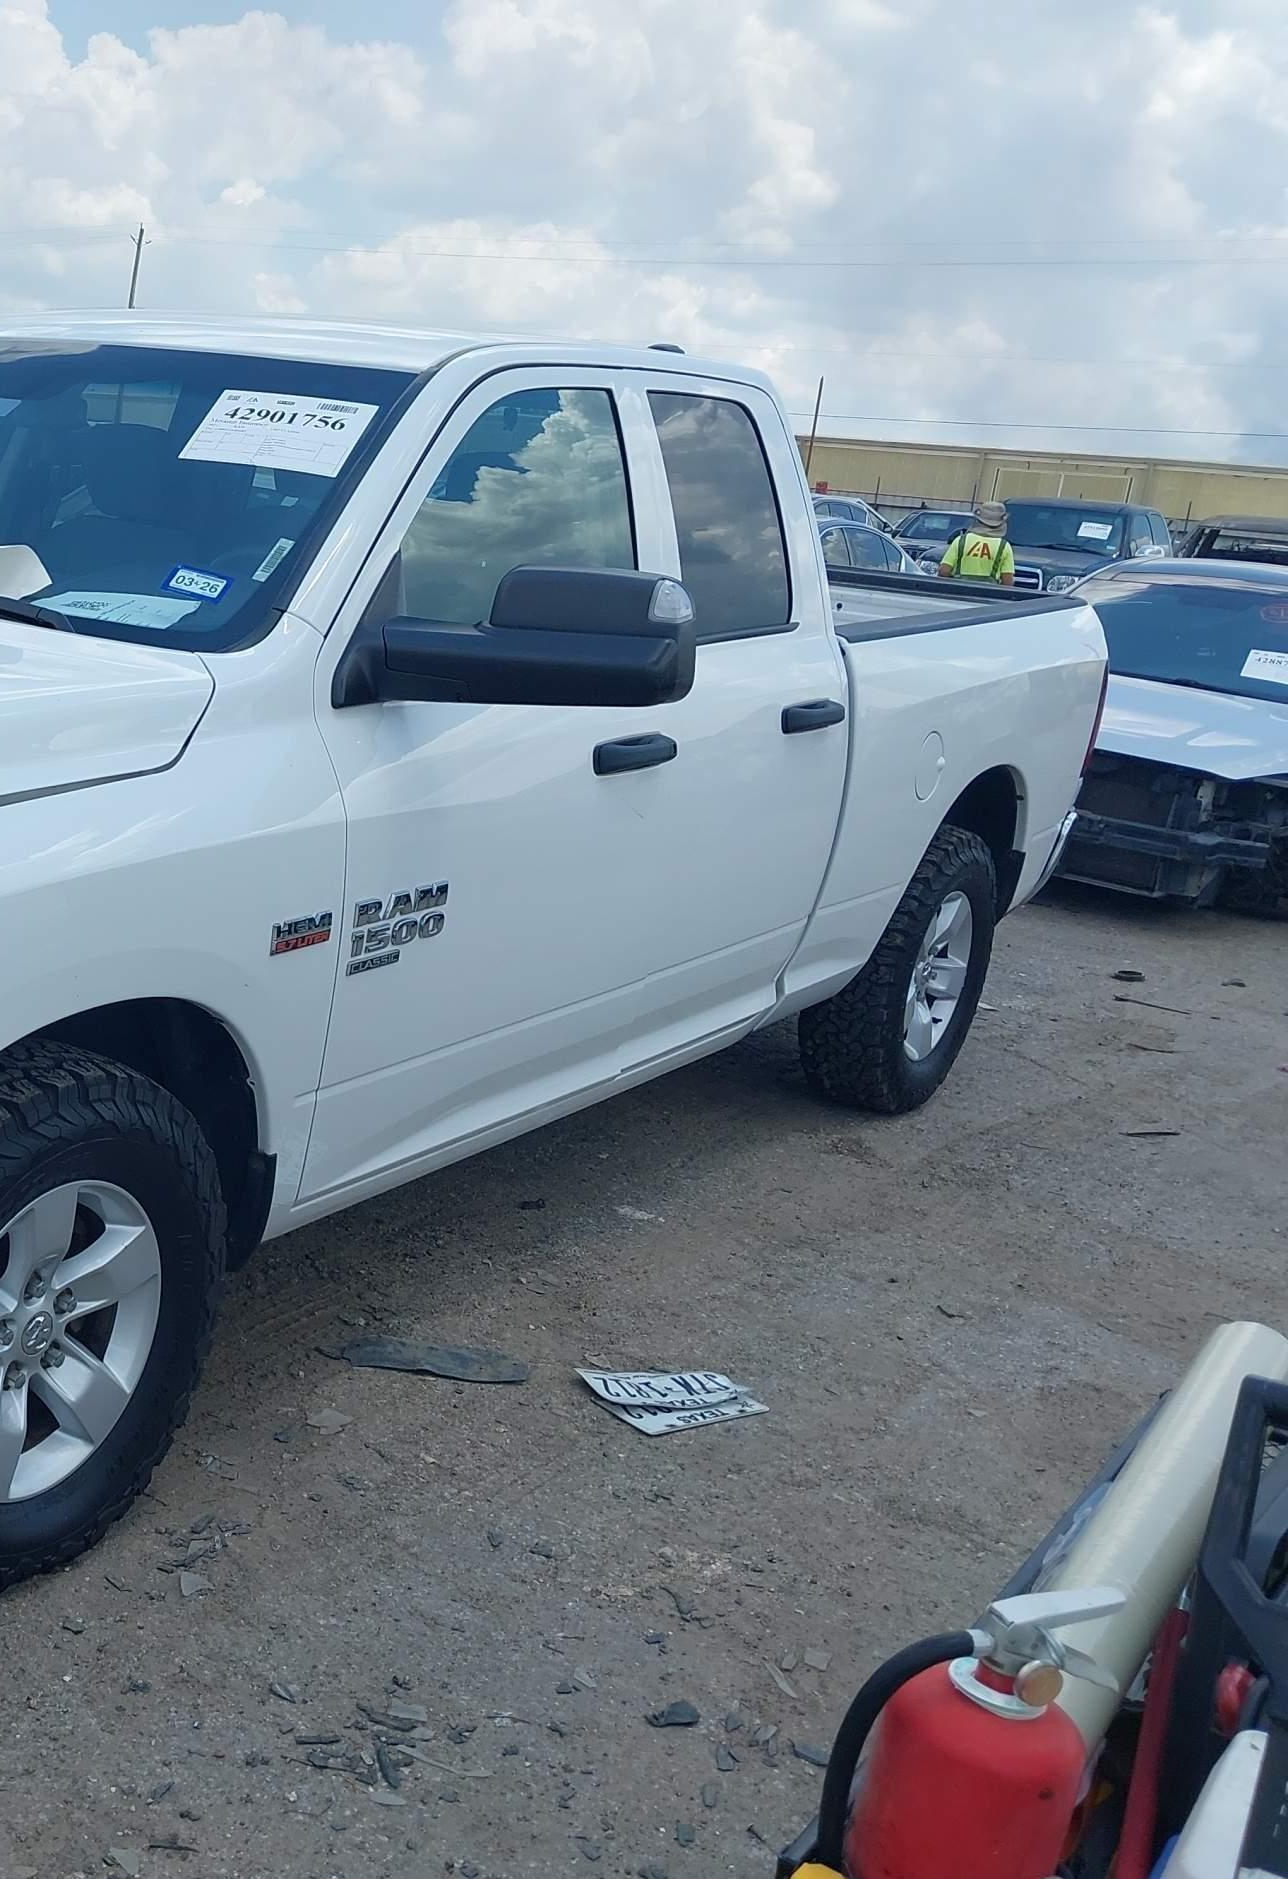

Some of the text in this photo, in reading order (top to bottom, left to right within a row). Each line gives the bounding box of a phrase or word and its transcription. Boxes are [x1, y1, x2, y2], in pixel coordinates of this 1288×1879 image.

[224, 406, 349, 431] 42901756
[353, 880, 449, 929] RAM
[350, 911, 445, 958] 1500
[350, 951, 400, 974] CLASSIC
[676, 1408, 730, 1424] TEXAS
